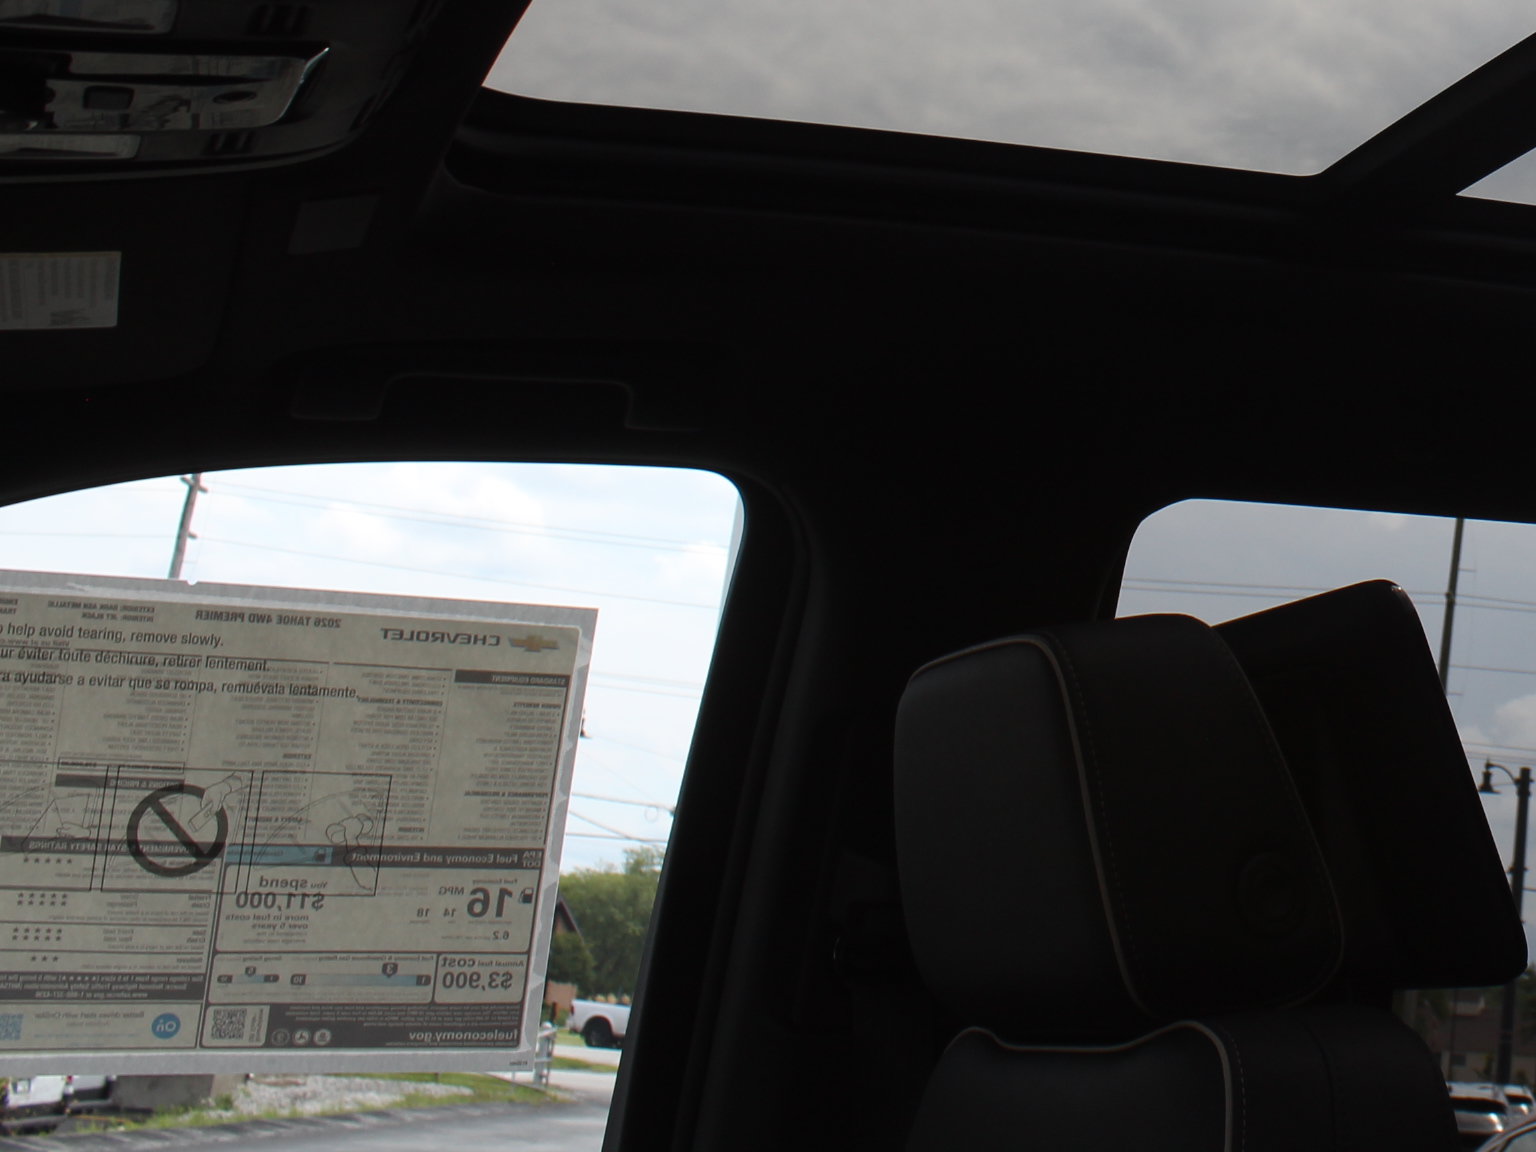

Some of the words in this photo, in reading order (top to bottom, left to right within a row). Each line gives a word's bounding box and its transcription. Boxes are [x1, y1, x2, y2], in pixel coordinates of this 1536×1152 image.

[8, 622, 35, 638] help
[39, 625, 74, 638] avoid
[77, 627, 126, 643] tearing,
[130, 630, 177, 644] remove
[181, 632, 224, 649] slowly.
[18, 646, 55, 661] éviter
[58, 649, 91, 663] toute
[95, 650, 159, 667] déchirure,
[163, 654, 202, 668] retirer
[205, 655, 271, 672] lentement.
[14, 671, 74, 685] ayudarse
[77, 677, 85, 686] a
[89, 675, 126, 688] evitar
[128, 677, 152, 691] que
[156, 679, 170, 690] se
[174, 680, 217, 694] rompa,
[221, 681, 285, 696] remuévala
[289, 682, 360, 698] lentamente.
